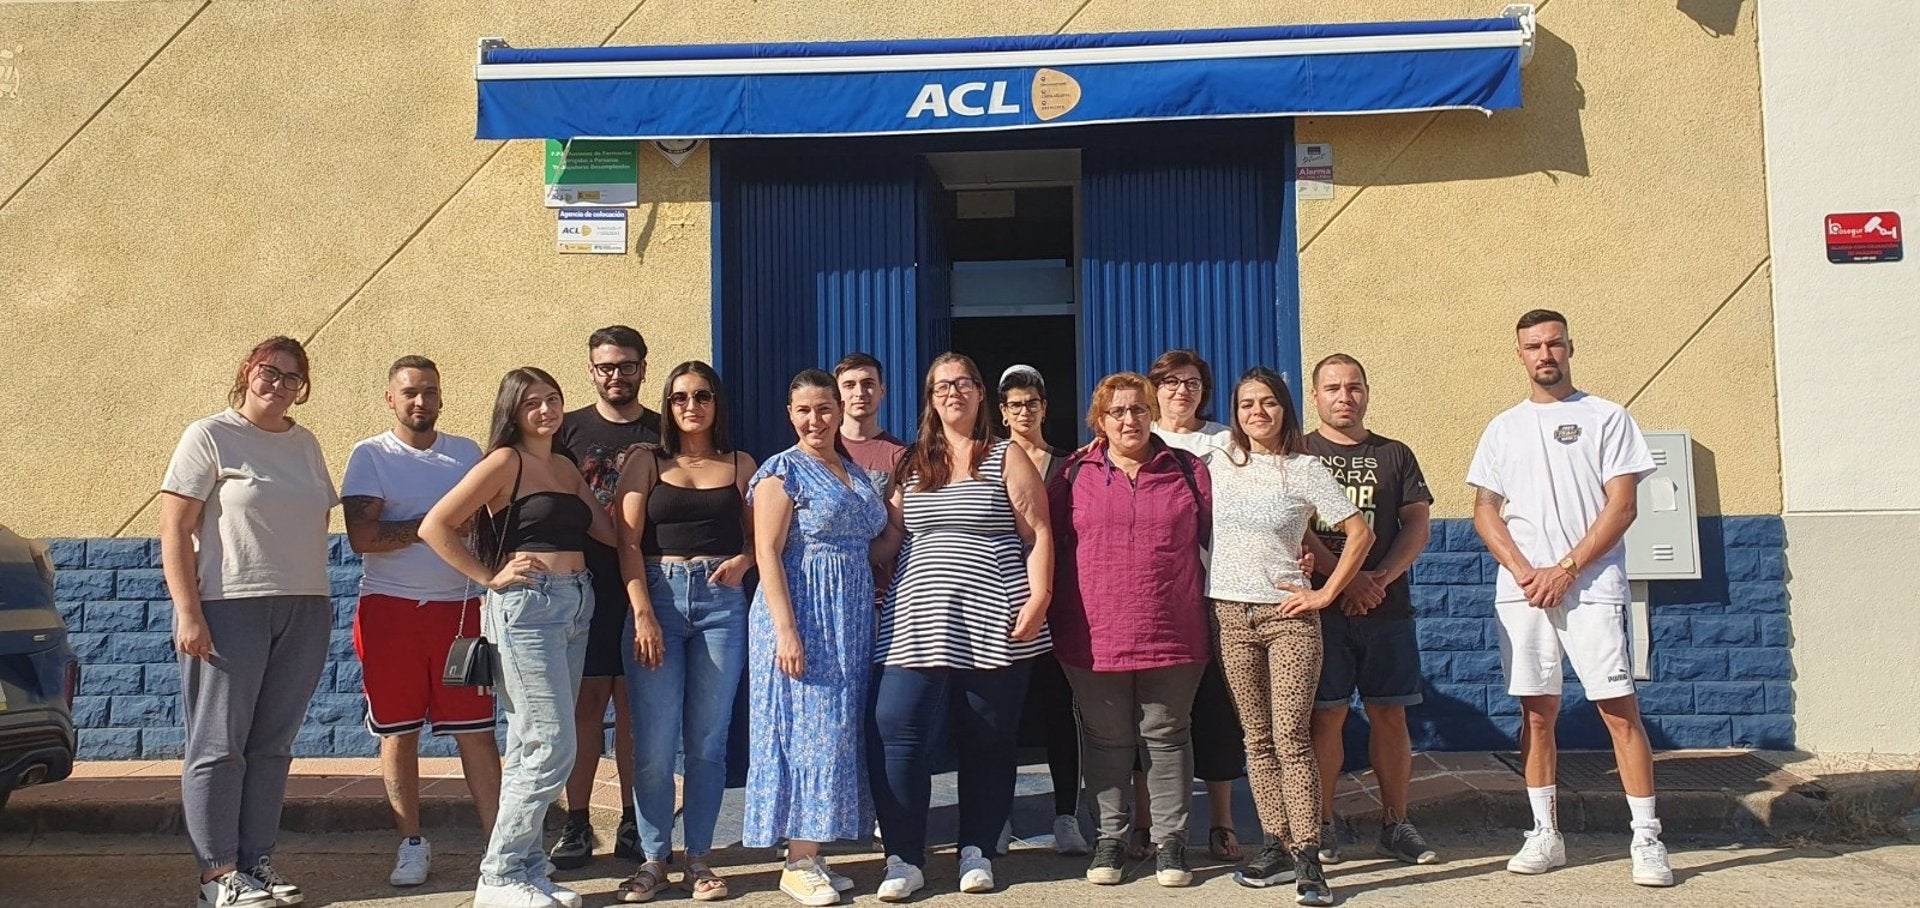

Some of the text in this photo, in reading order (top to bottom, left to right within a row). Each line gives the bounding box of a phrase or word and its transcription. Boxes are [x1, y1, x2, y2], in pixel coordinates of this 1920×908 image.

[905, 81, 1020, 118] ACL
[560, 210, 584, 219] Agencia
[562, 227, 581, 235] ACL
[1319, 455, 1378, 469] NO ES
